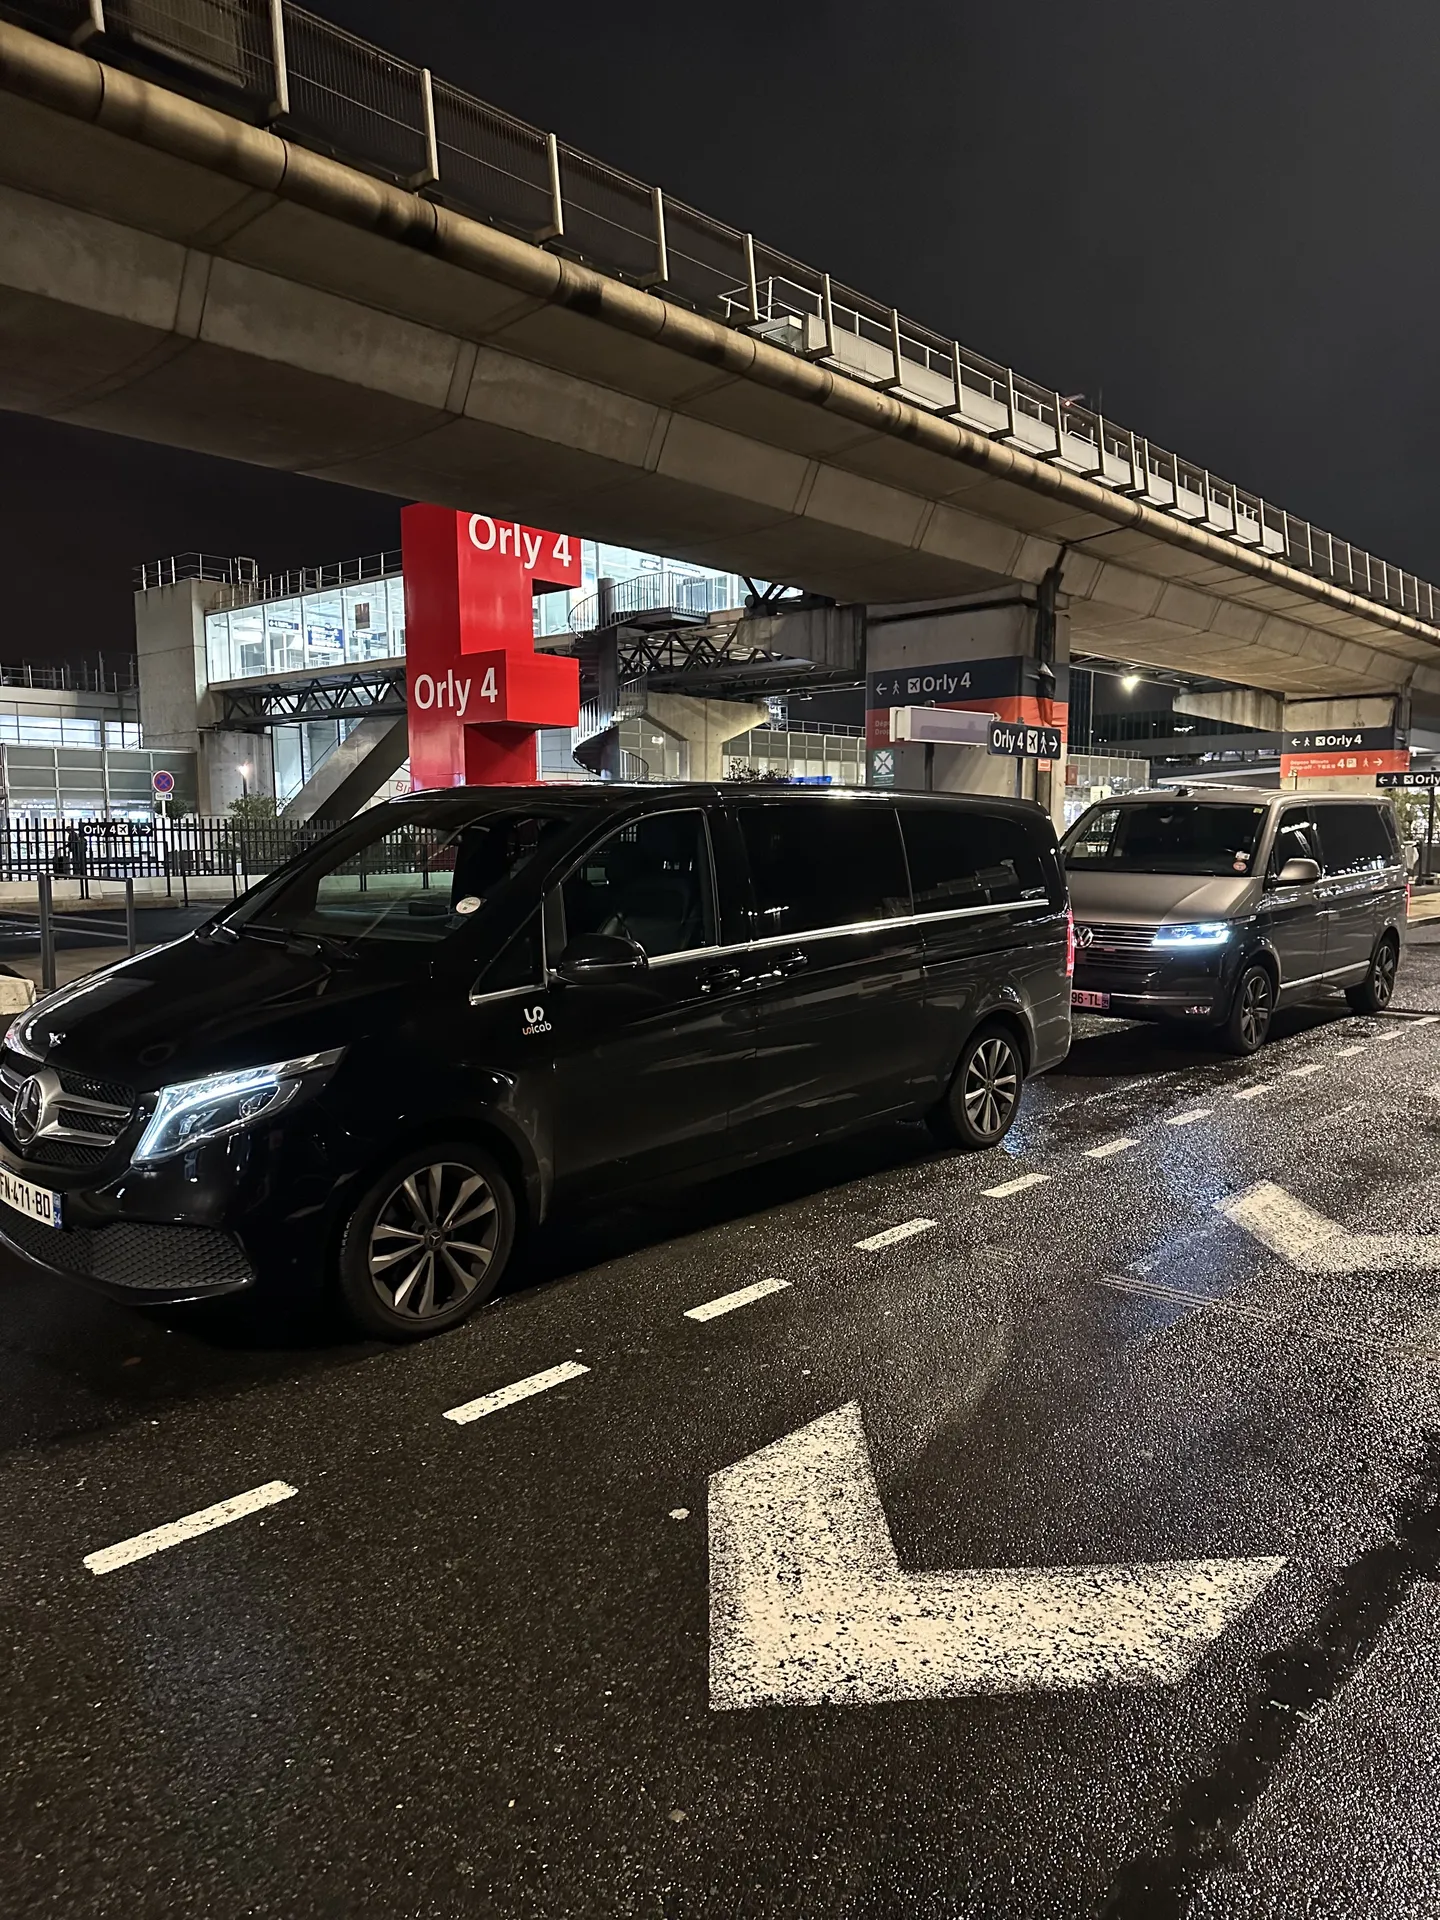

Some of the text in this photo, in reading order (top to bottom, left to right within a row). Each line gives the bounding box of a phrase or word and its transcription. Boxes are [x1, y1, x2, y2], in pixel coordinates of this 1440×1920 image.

[468, 513, 573, 570] Orly 4
[414, 667, 498, 717] Orly 4
[922, 672, 972, 694] Orly 4
[993, 729, 1024, 753] Orly 4
[1326, 735, 1363, 748] Orly 4
[1337, 758, 1346, 769] 4
[83, 825, 116, 836] Orly 4
